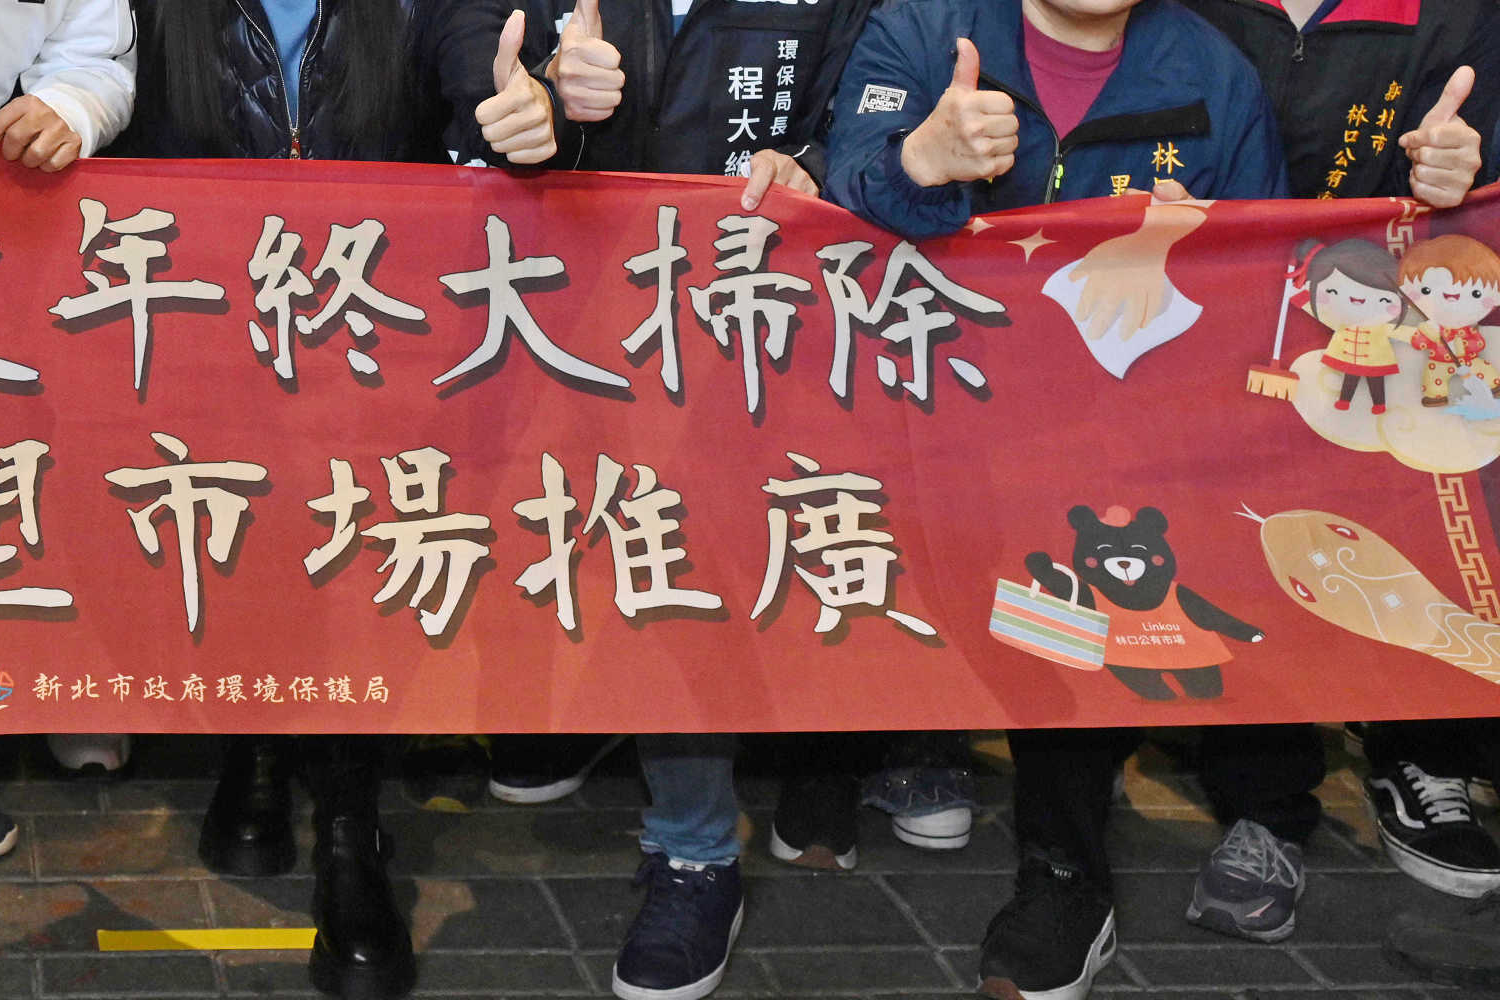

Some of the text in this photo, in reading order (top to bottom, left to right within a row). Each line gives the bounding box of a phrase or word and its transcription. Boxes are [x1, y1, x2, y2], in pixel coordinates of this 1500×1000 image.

[769, 39, 799, 137] 環保局長
[1370, 80, 1403, 157] 新北市
[1115, 634, 1186, 646] 林口公有市場
[1141, 621, 1181, 632] Linkou
[31, 671, 391, 704] 新北市政府環境保護局
